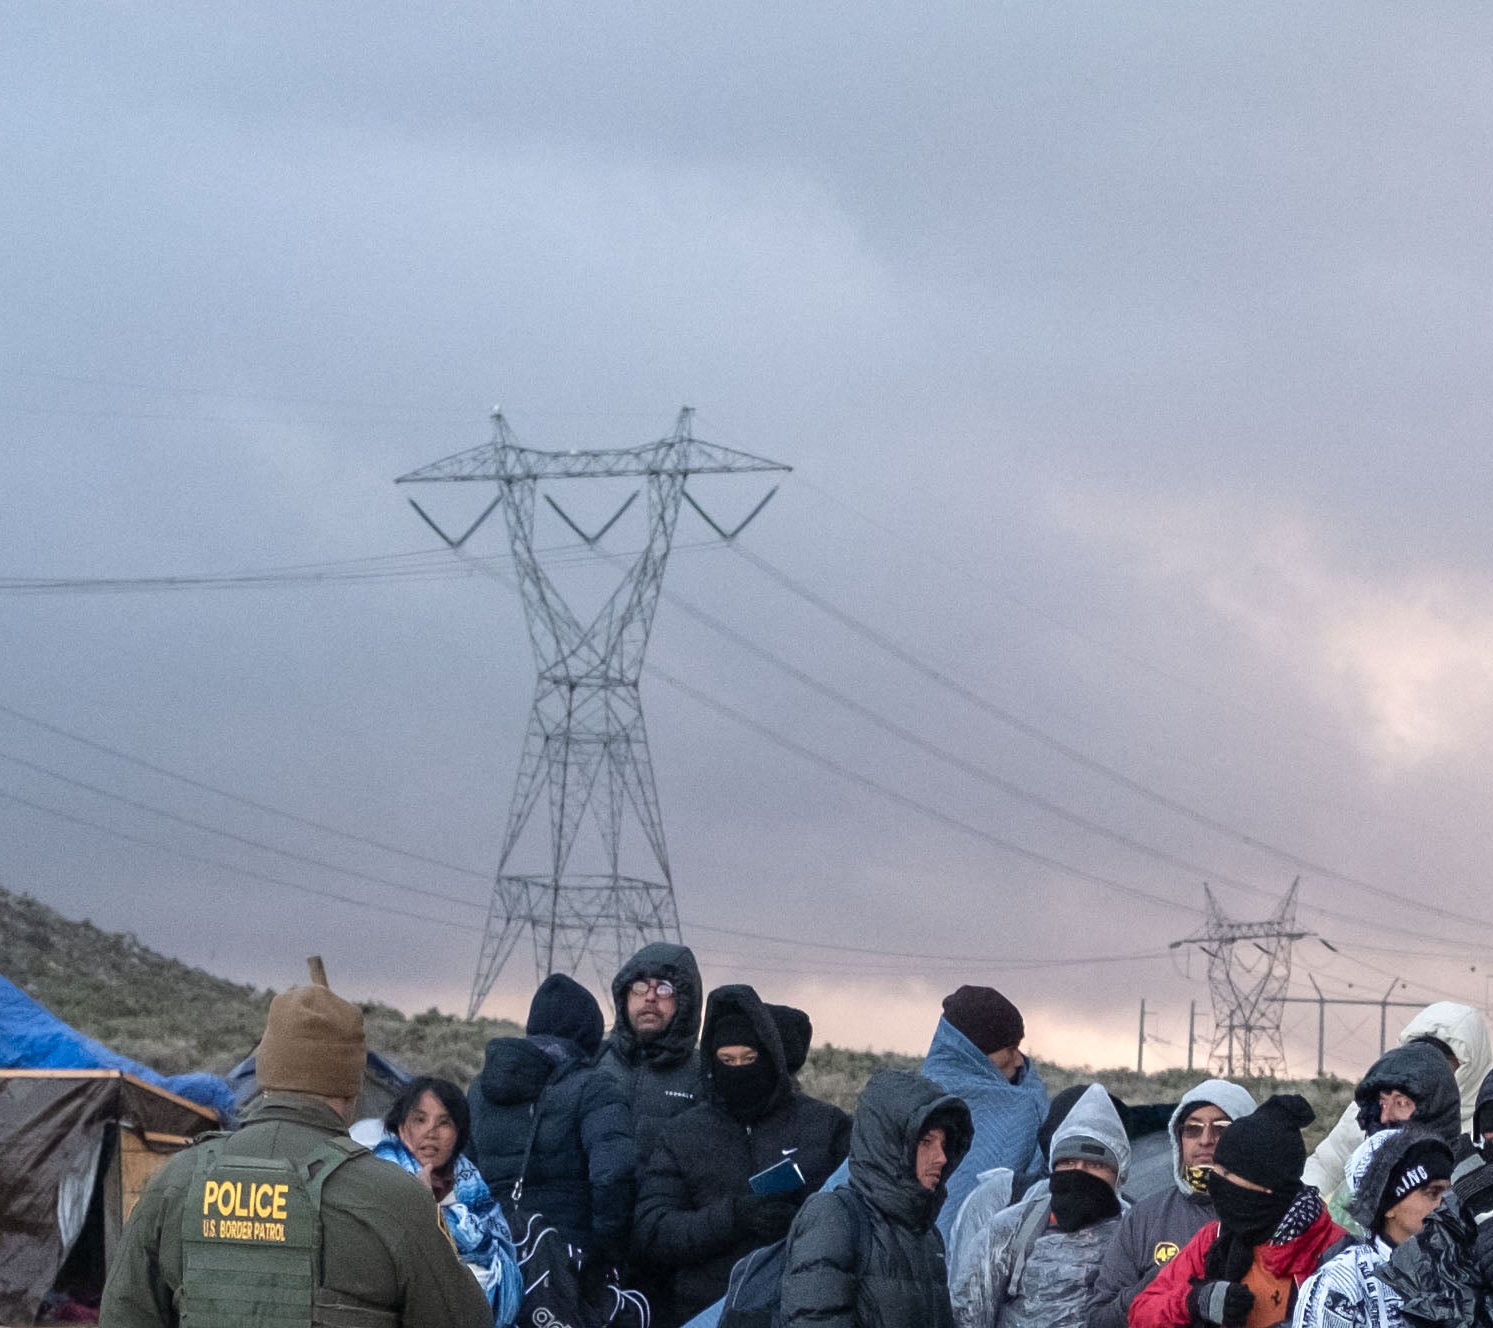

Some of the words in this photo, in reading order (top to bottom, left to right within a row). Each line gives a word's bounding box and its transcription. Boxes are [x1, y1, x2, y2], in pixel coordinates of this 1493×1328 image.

[203, 1181, 289, 1219] POLICE
[203, 1220, 217, 1238] U.S.
[219, 1220, 252, 1240] BORDER
[253, 1222, 286, 1242] PATROL
